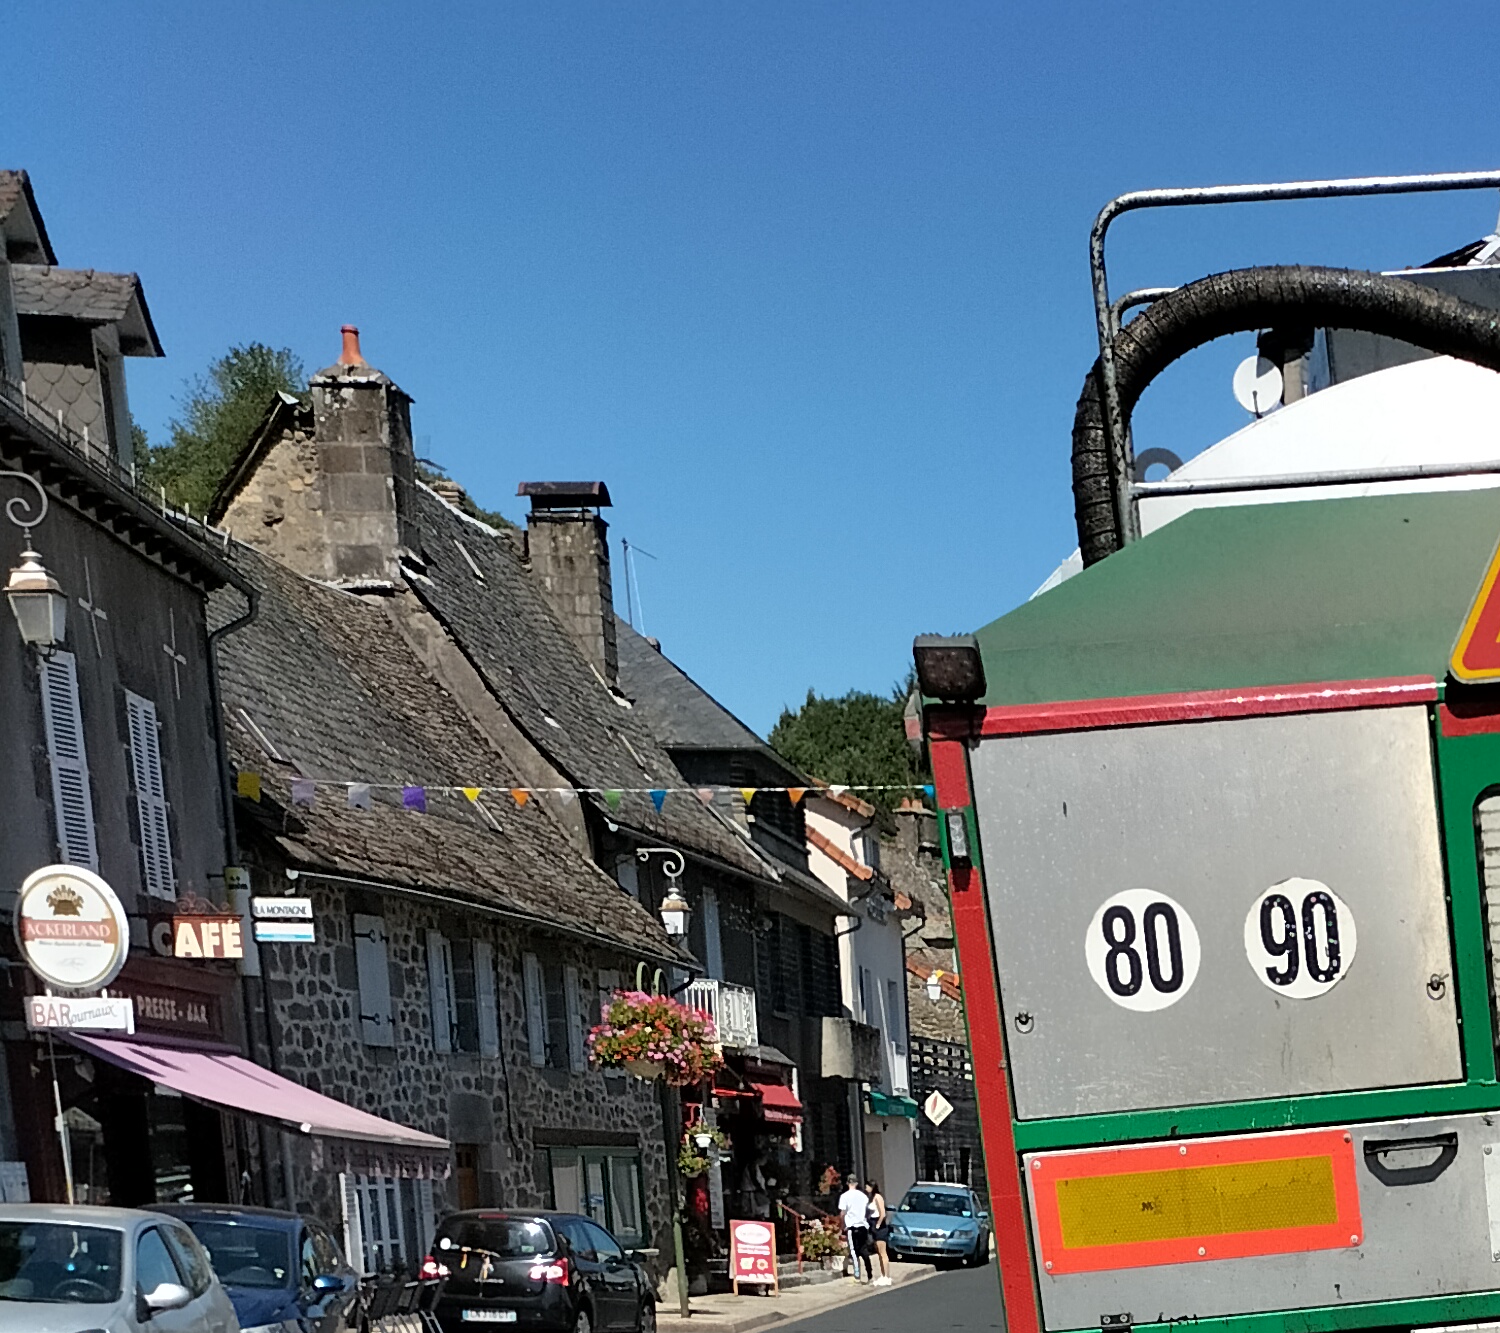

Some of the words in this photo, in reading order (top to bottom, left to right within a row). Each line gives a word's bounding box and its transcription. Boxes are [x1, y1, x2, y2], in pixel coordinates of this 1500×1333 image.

[255, 906, 266, 915] LA
[267, 906, 307, 916] MONTAGNE
[26, 923, 111, 938] ACKERLAND
[151, 919, 243, 958] CAFÉ
[1258, 890, 1343, 986] 90
[1101, 901, 1185, 997] 80
[32, 1003, 73, 1027] BAR
[136, 995, 177, 1022] PRESSE
